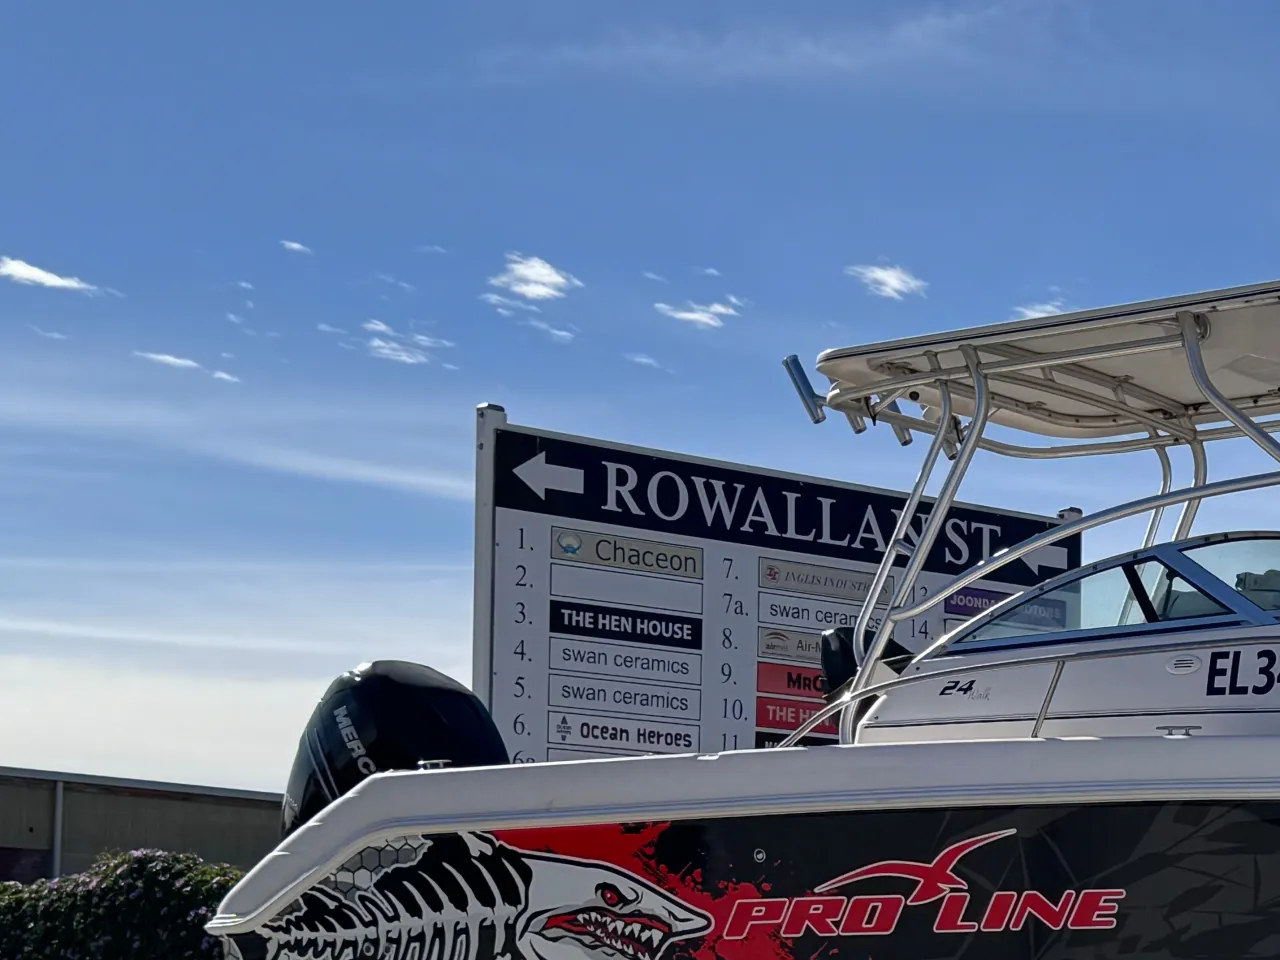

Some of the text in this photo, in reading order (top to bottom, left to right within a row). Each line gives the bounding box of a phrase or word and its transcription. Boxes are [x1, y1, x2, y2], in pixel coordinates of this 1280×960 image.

[601, 461, 1001, 565] ROWALLAN ST
[518, 528, 696, 573] 1. Chaceon
[515, 565, 533, 588] 2.
[722, 558, 739, 580] 7.
[785, 571, 821, 585] INGLIS
[823, 576, 888, 594] INDUSTRS
[514, 602, 692, 640] 3. THE HEN HOUSE
[722, 593, 882, 630] 7a. swan ceramcs
[911, 618, 934, 640] 14.
[722, 627, 738, 650] 8.
[513, 640, 689, 675] 4. swan ceramics
[721, 663, 737, 685] 9.
[513, 676, 689, 711] 5. swan ceramics
[939, 680, 977, 696] 24
[722, 698, 748, 721] 10.
[766, 705, 796, 723] THE
[513, 713, 531, 736] 6.
[580, 722, 629, 742] Ocean
[637, 728, 692, 748] Heroes
[723, 888, 1126, 940] PRO LINE
